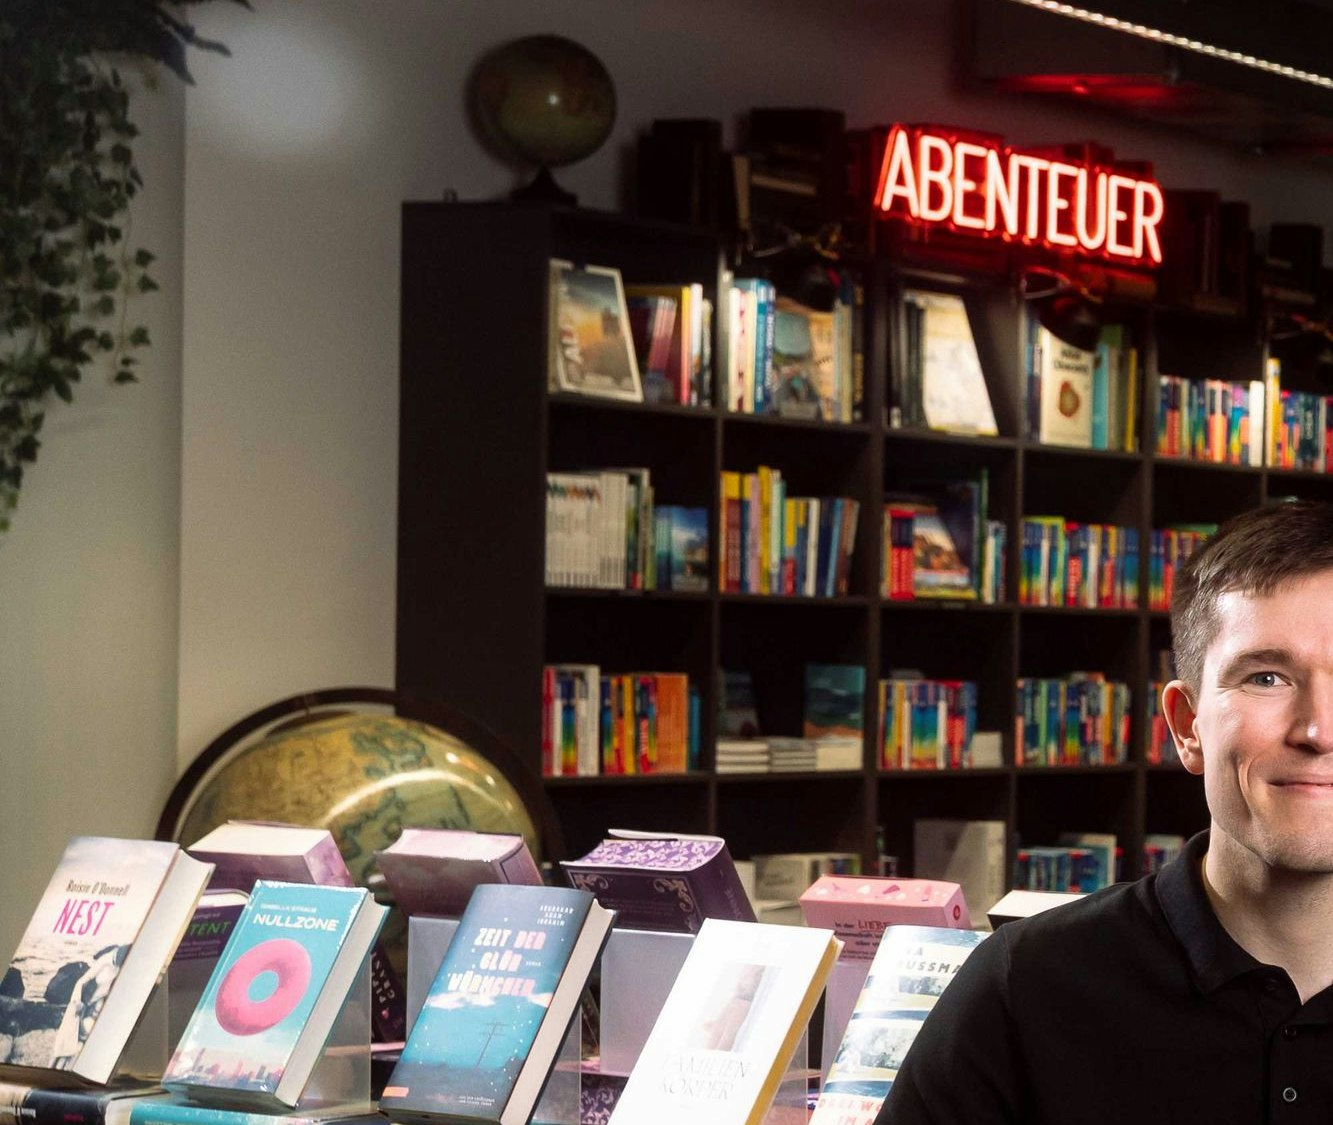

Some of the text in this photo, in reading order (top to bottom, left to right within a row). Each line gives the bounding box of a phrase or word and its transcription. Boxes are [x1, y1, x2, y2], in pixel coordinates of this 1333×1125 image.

[880, 129, 1164, 263] ABENTEUER
[52, 898, 115, 937] NEST
[252, 912, 340, 933] NULLZONE
[474, 927, 546, 950] ZEIT DER
